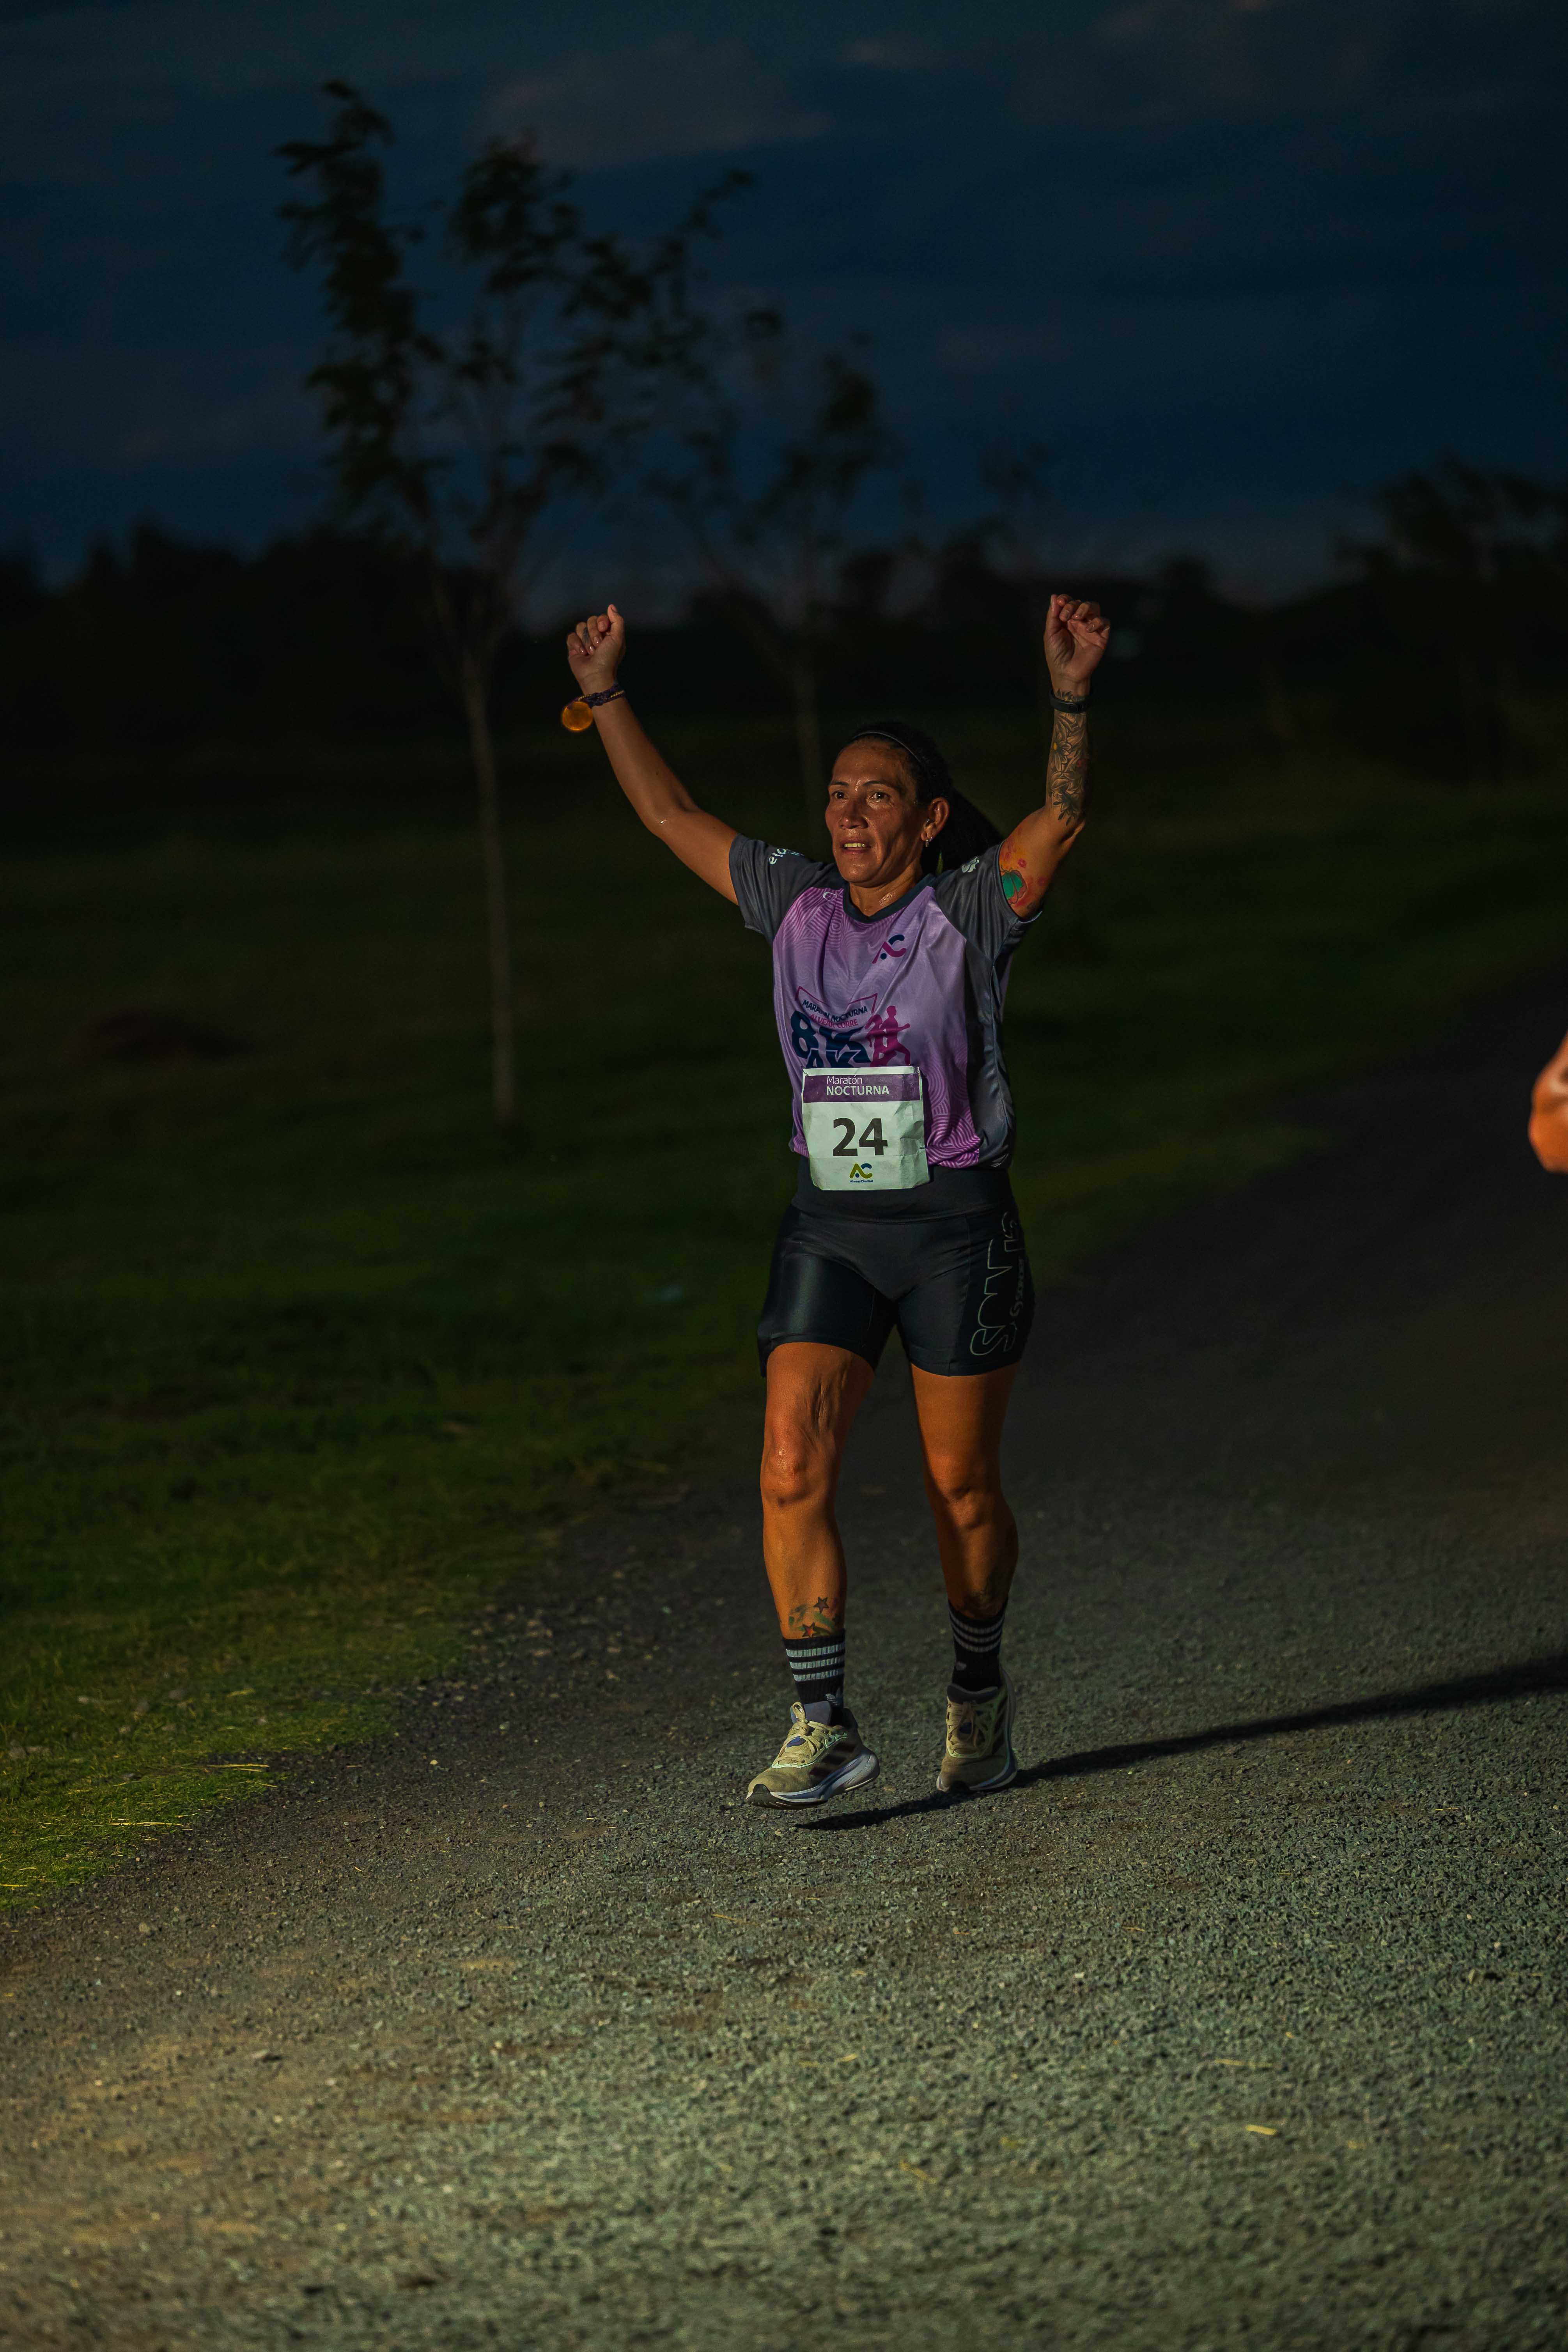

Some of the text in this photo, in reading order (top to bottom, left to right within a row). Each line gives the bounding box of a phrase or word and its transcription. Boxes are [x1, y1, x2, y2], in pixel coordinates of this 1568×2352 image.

[810, 1014, 858, 1029] ALVEAR CORRE
[831, 1006, 868, 1022] NOCTURNA
[826, 1075, 863, 1085] Maratón
[826, 1085, 890, 1095] NOCTURNA
[833, 1118, 888, 1156] 24
